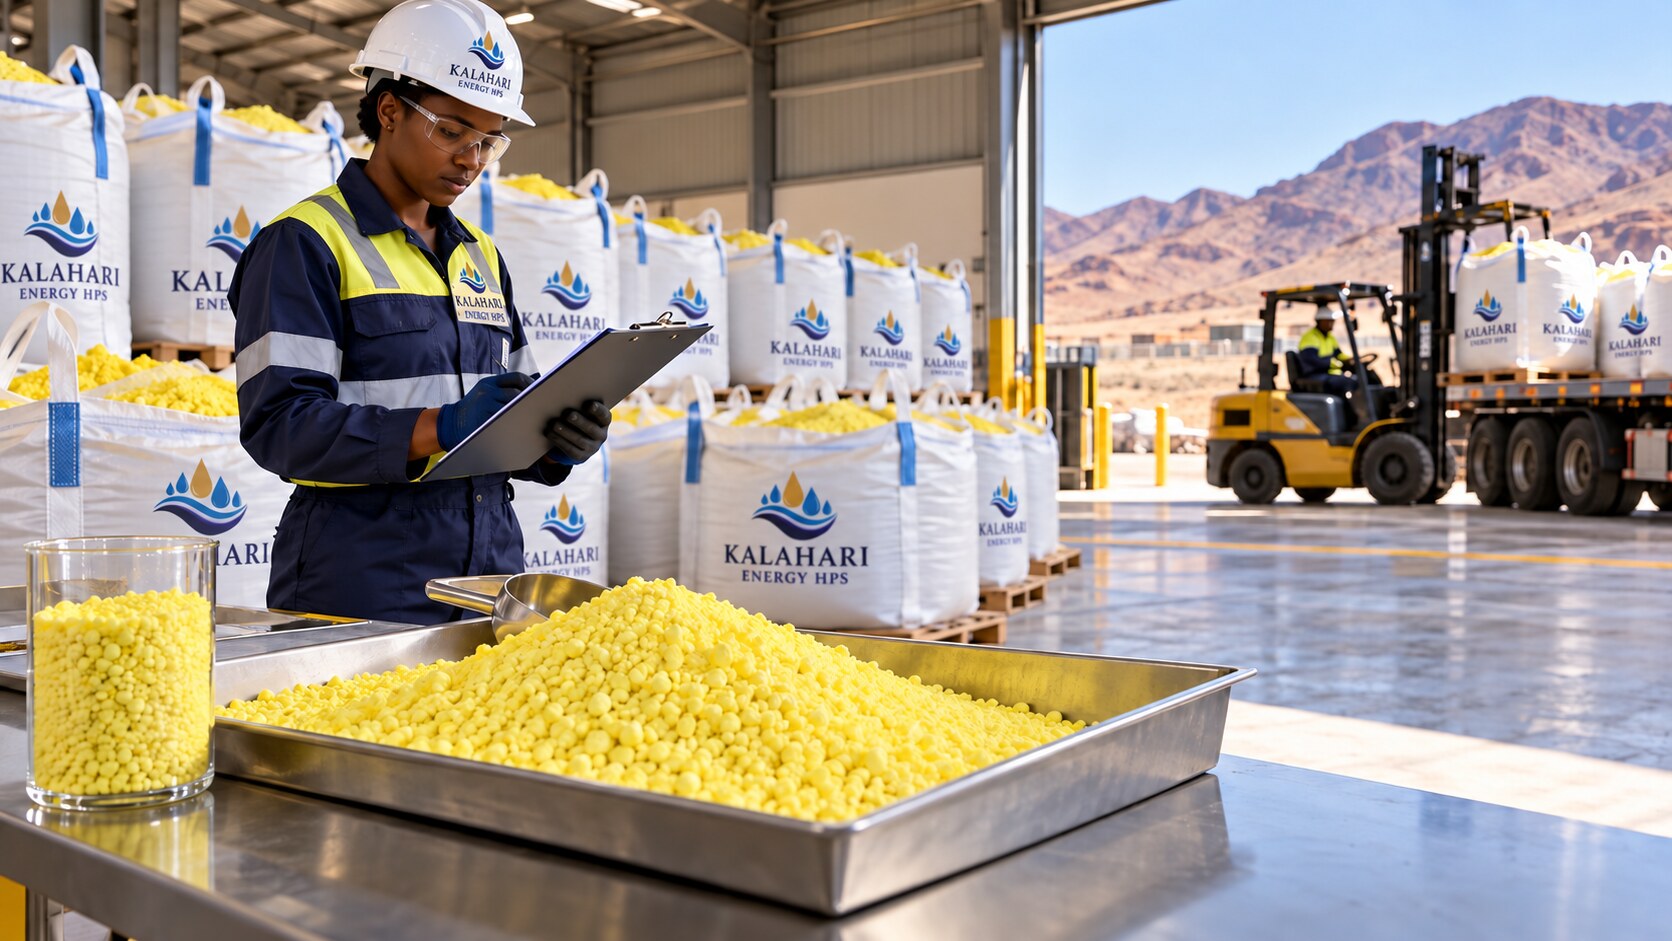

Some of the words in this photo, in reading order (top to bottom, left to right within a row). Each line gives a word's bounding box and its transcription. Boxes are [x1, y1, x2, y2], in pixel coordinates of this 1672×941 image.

[450, 64, 511, 90] KALAHARI
[458, 80, 490, 94] ENERGY
[491, 88, 503, 98] HPS
[1, 262, 120, 286] KALAHARI
[19, 287, 78, 300] ENERGY
[84, 289, 108, 302] HPS
[455, 295, 503, 309] KALAHARI
[196, 297, 231, 311] ENE
[521, 312, 605, 331] KALAHARI
[535, 331, 577, 341] ENERGY
[1464, 322, 1517, 339] KALAHARI
[1543, 323, 1592, 338] KALAHARI
[770, 340, 842, 360] KALAHARI
[1608, 336, 1661, 352] KALAHARI
[860, 345, 913, 361] KALAHARI
[783, 358, 818, 367] ENERGY
[923, 357, 968, 370] KALAHARI
[978, 521, 1027, 537] KALAHARI
[724, 544, 869, 567] KALAHARI
[741, 569, 808, 584] ENERGY
[815, 572, 849, 585] HPS
